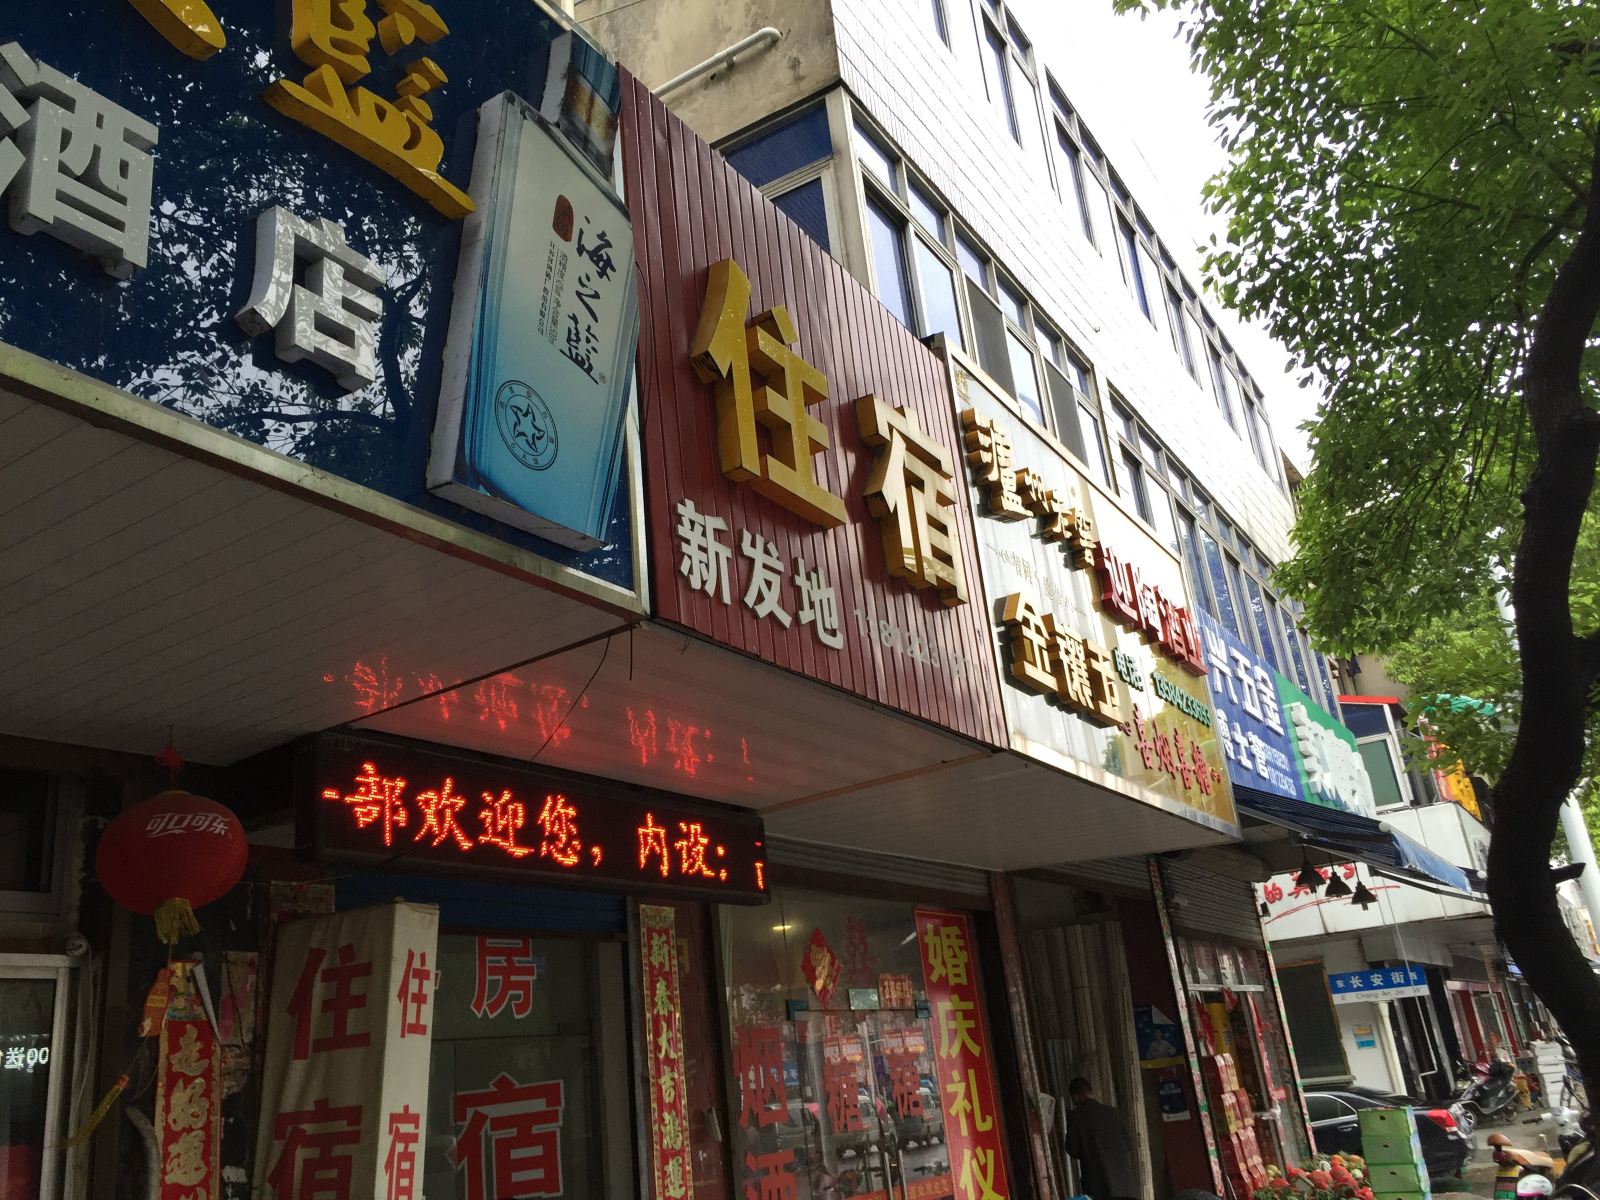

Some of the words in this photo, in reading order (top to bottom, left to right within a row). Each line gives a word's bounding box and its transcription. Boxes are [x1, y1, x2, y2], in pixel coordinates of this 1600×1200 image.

[0, 40, 387, 394] 酒店
[690, 258, 968, 607] 住宿
[675, 498, 844, 650] 新发地
[267, 943, 373, 1200] 住宿
[384, 948, 431, 1200] 住宿
[923, 922, 1012, 1200] 婚庆礼仪
[1349, 971, 1405, 989] 长安街
[1355, 991, 1379, 1000] Chang
[447, 1073, 566, 1200] 宿
